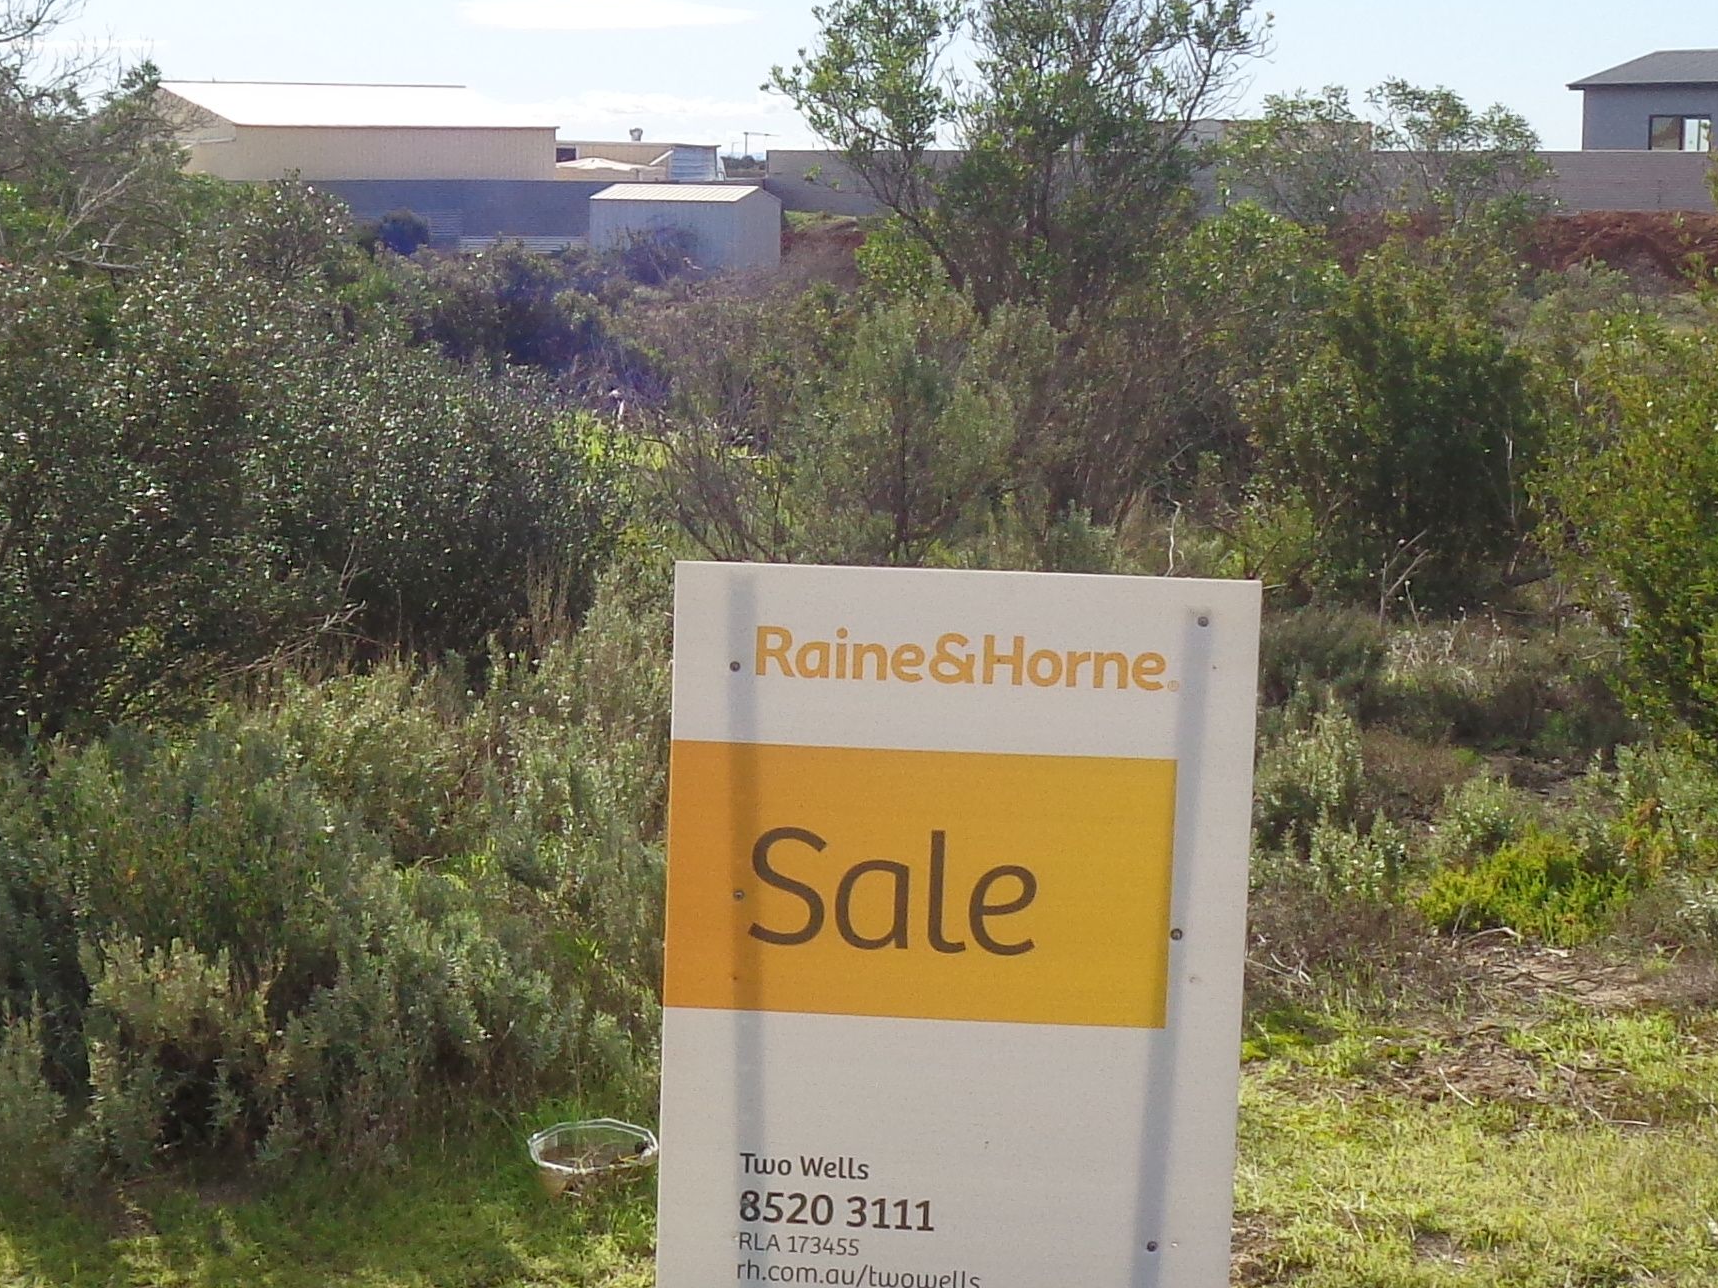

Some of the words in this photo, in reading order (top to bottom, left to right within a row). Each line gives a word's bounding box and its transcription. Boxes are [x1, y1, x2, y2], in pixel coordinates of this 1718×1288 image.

[754, 625, 1167, 691] Raine&Horne
[747, 826, 1038, 956] Sale
[740, 1152, 792, 1176] Two
[800, 1155, 870, 1180] Wells
[739, 1189, 834, 1226] 8520
[846, 1195, 935, 1232] 3111
[739, 1231, 781, 1253] RLA
[787, 1235, 860, 1257] 173455
